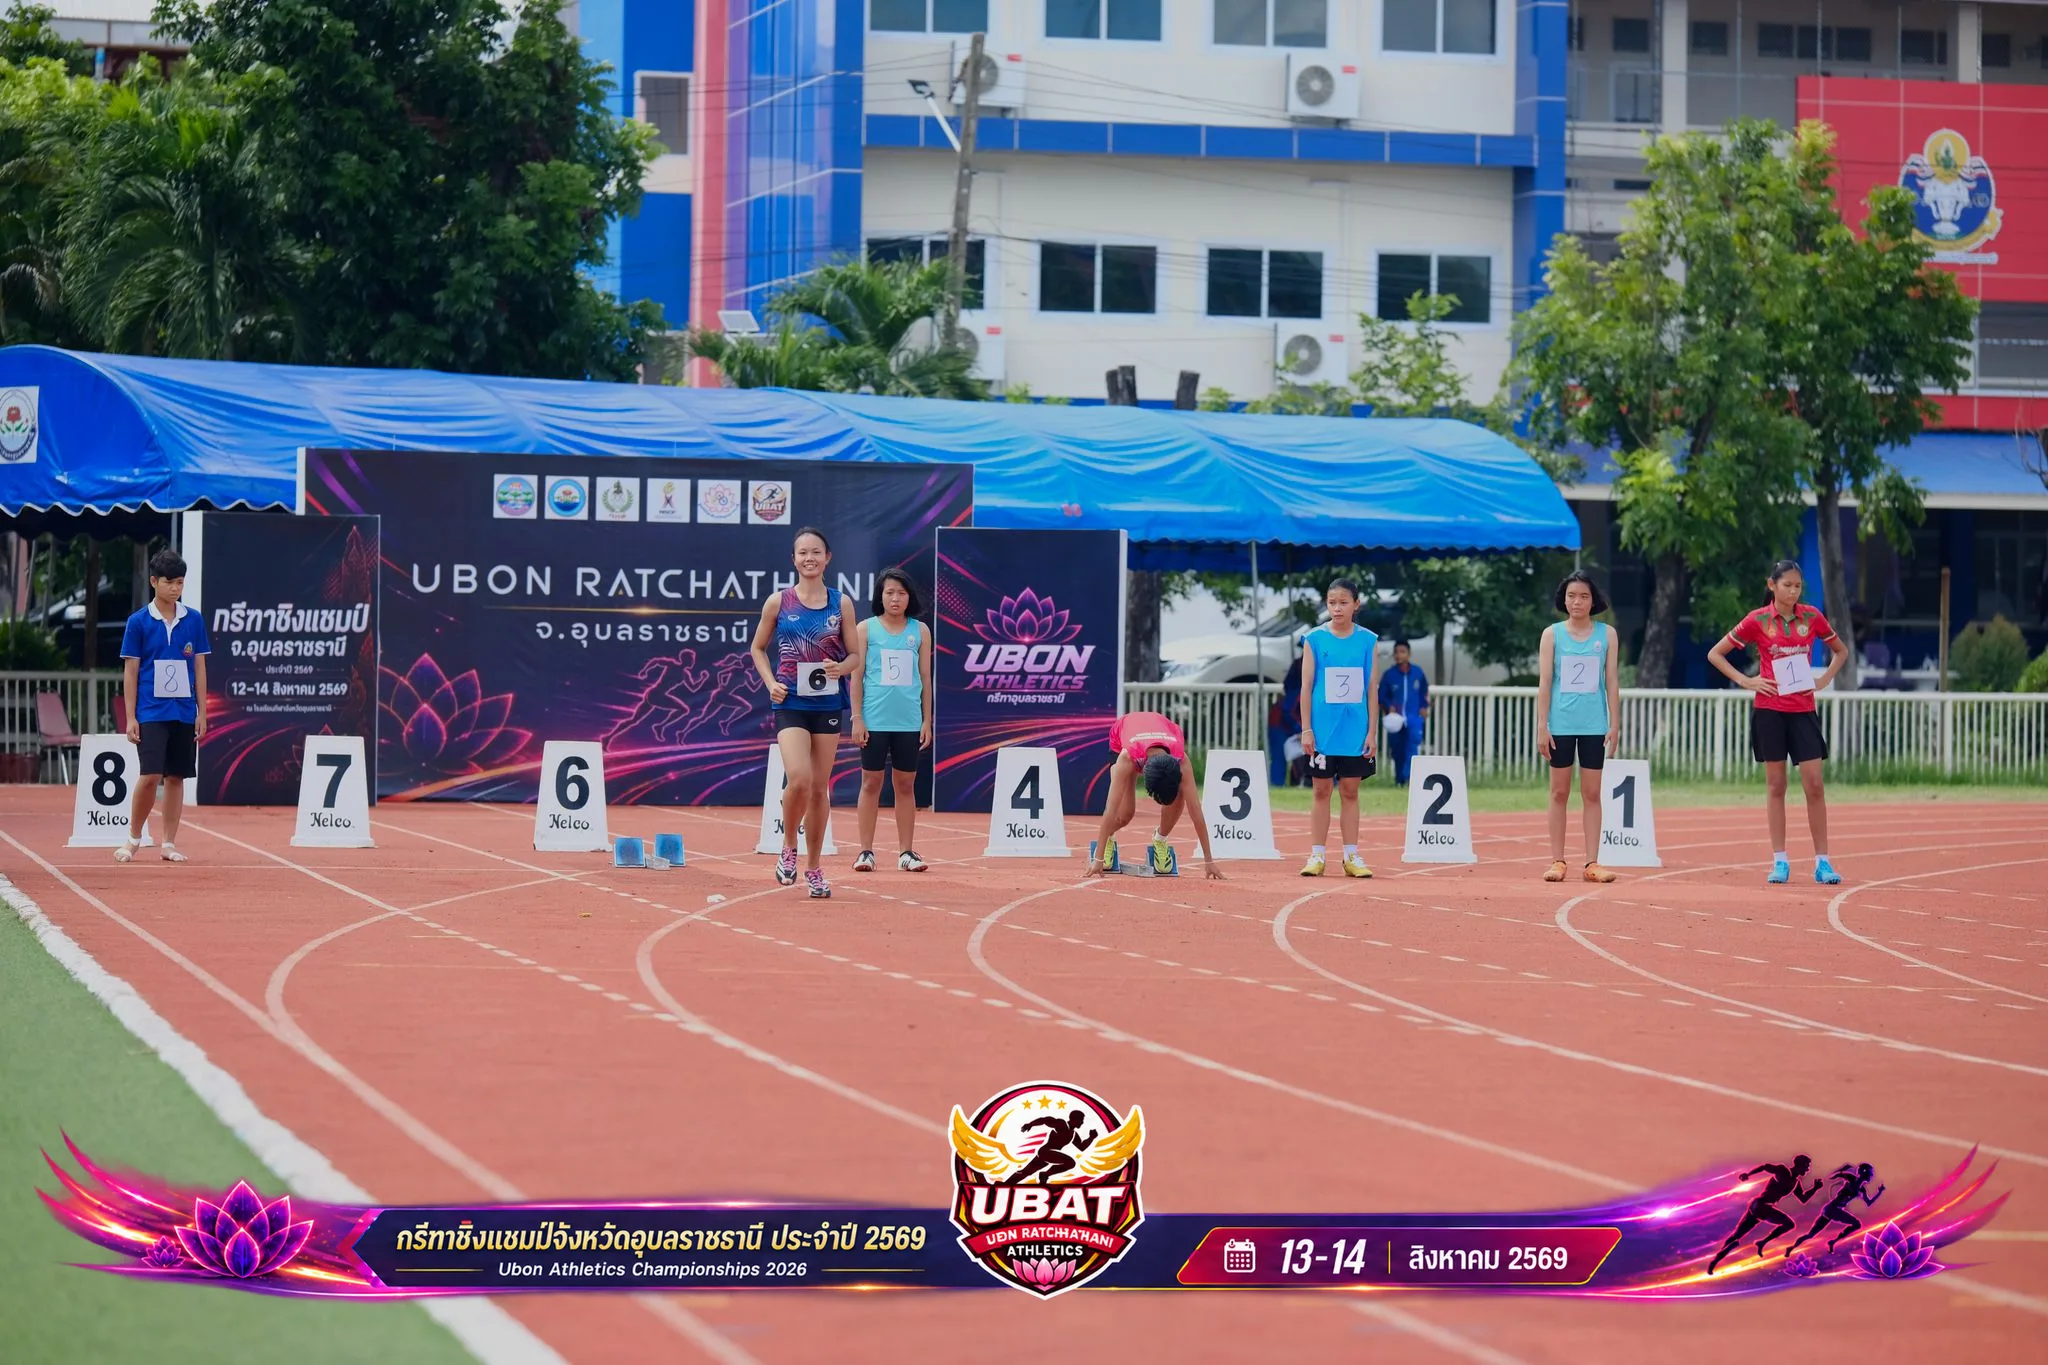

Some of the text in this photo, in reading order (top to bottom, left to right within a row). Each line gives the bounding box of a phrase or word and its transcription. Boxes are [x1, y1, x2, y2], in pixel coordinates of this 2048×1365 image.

[412, 562, 875, 602] UBON RATCHATHNI
[213, 601, 370, 633] กรีฑาชิงแชมป์
[535, 618, 749, 649] จ.อุบลราชธานี
[231, 635, 347, 662] จ.อุบลราชธานี
[964, 643, 1096, 673] UBON
[163, 664, 179, 693] 8
[293, 664, 314, 675] 2569
[808, 668, 828, 691] 6
[887, 655, 901, 681] 5
[1570, 662, 1585, 685] 2
[1786, 660, 1803, 687] 1
[272, 680, 316, 696] สิงหาคม
[318, 682, 348, 696] 2569
[964, 674, 1088, 690] ATHLETICS
[1335, 674, 1350, 698] 3
[1308, 753, 1327, 770] 14
[92, 751, 127, 806] 8
[316, 753, 352, 809] 7
[556, 756, 590, 810] 6
[1011, 765, 1045, 820] 4
[1219, 767, 1252, 821] 3
[1422, 773, 1454, 825] 2
[1612, 775, 1636, 828] 1
[87, 810, 129, 826] Nelco
[310, 812, 352, 828] Nelco
[549, 814, 590, 830] Nelco
[1006, 823, 1046, 838] Nelco
[1213, 824, 1253, 840] Nelco
[1418, 830, 1455, 845] Nelco
[1603, 830, 1640, 847] Nelco
